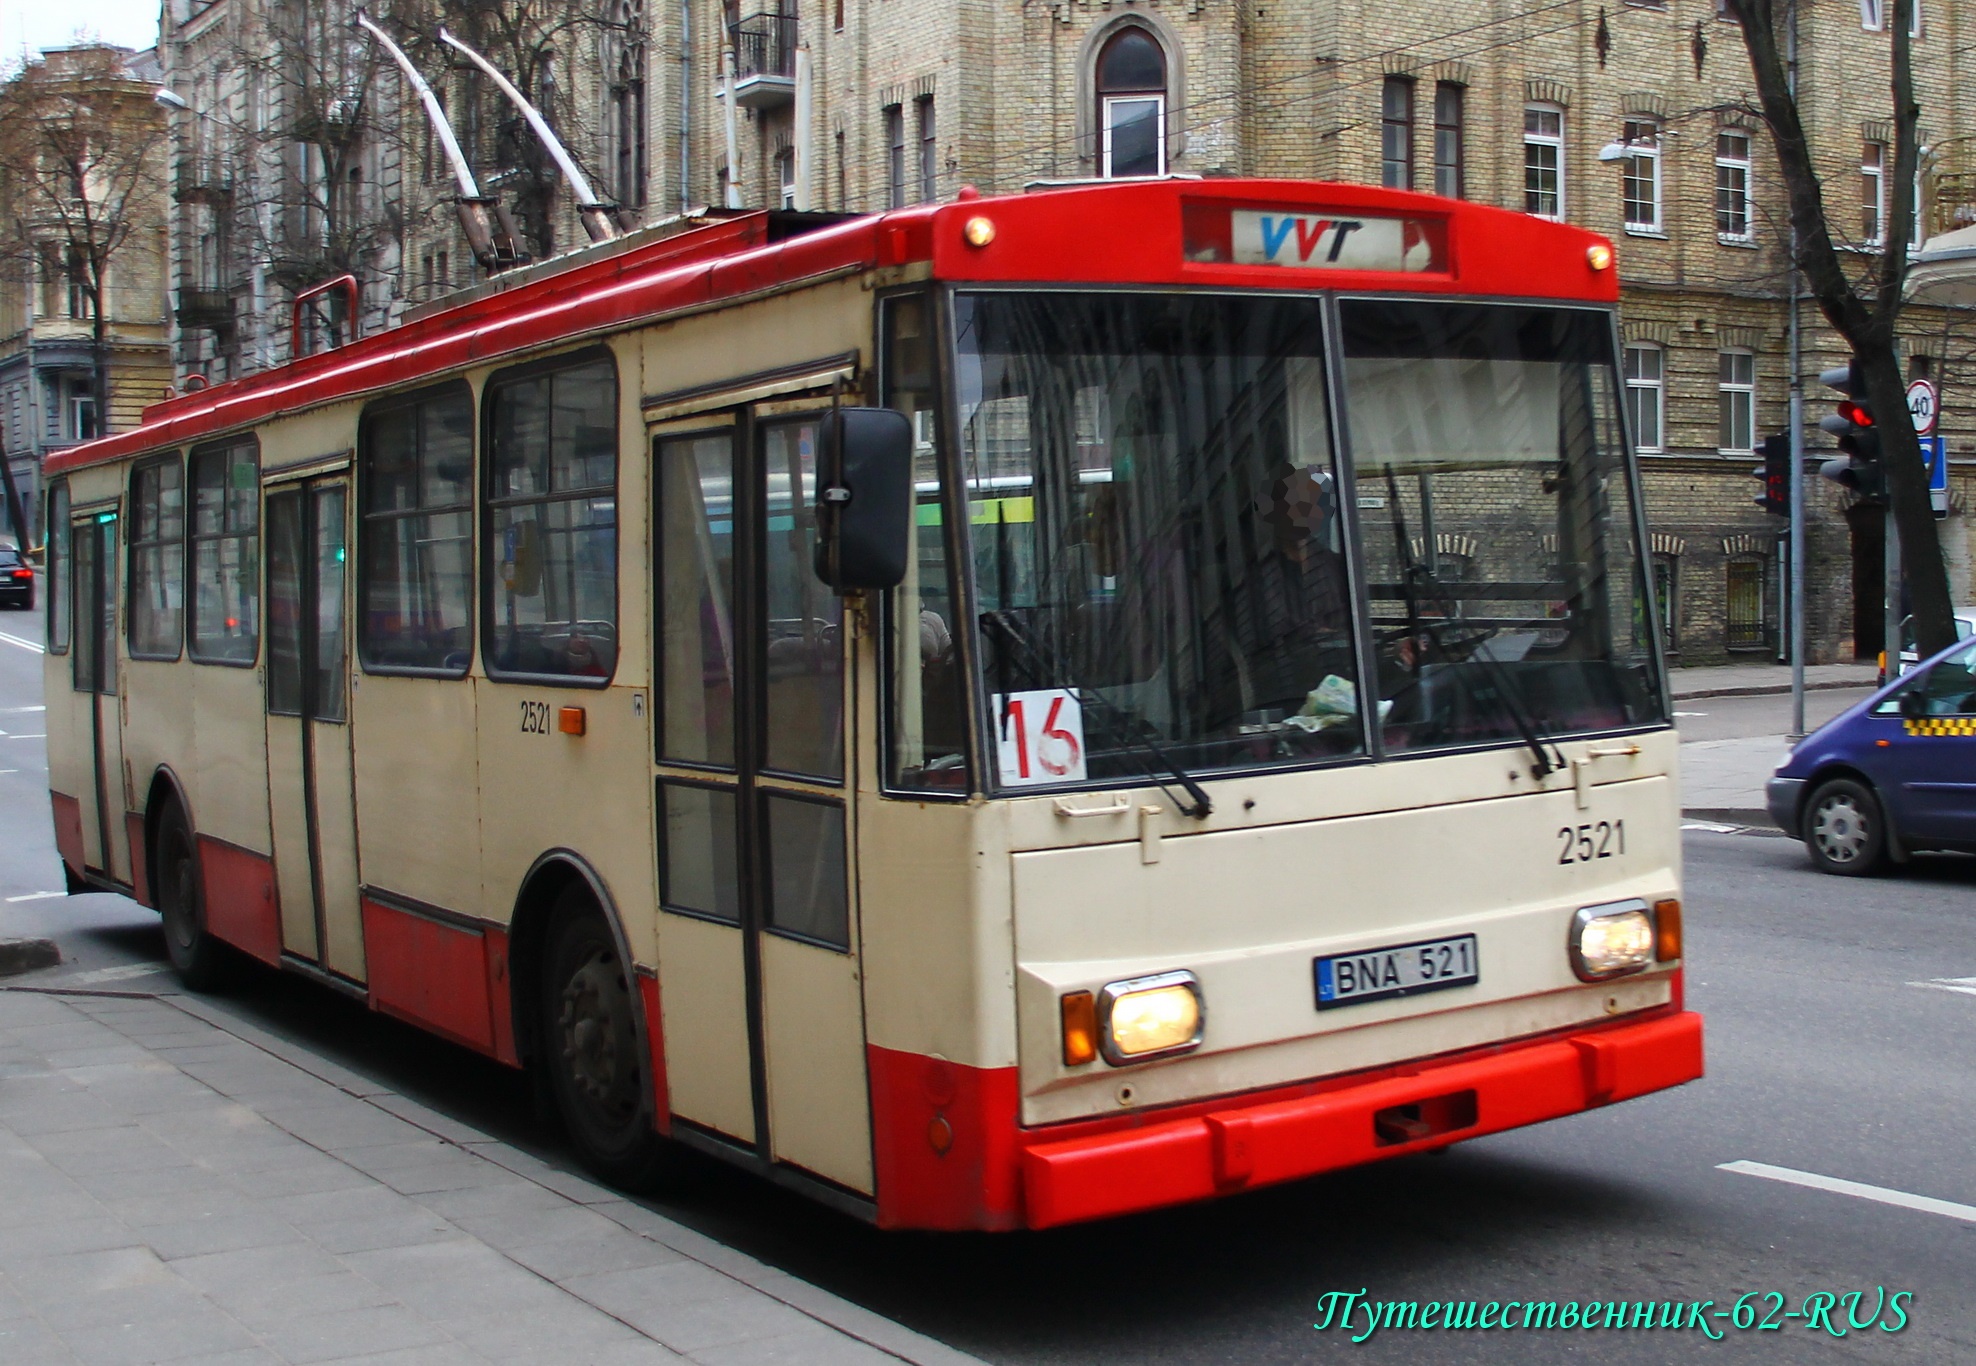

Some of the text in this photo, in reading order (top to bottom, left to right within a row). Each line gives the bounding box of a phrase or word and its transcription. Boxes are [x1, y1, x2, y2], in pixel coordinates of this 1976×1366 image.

[1261, 217, 1364, 262] VVT
[1911, 396, 1930, 417] 40
[521, 700, 551, 736] 2521
[999, 696, 1080, 779] 16
[1557, 818, 1625, 865] 2521
[1336, 942, 1470, 994] BNA 521
